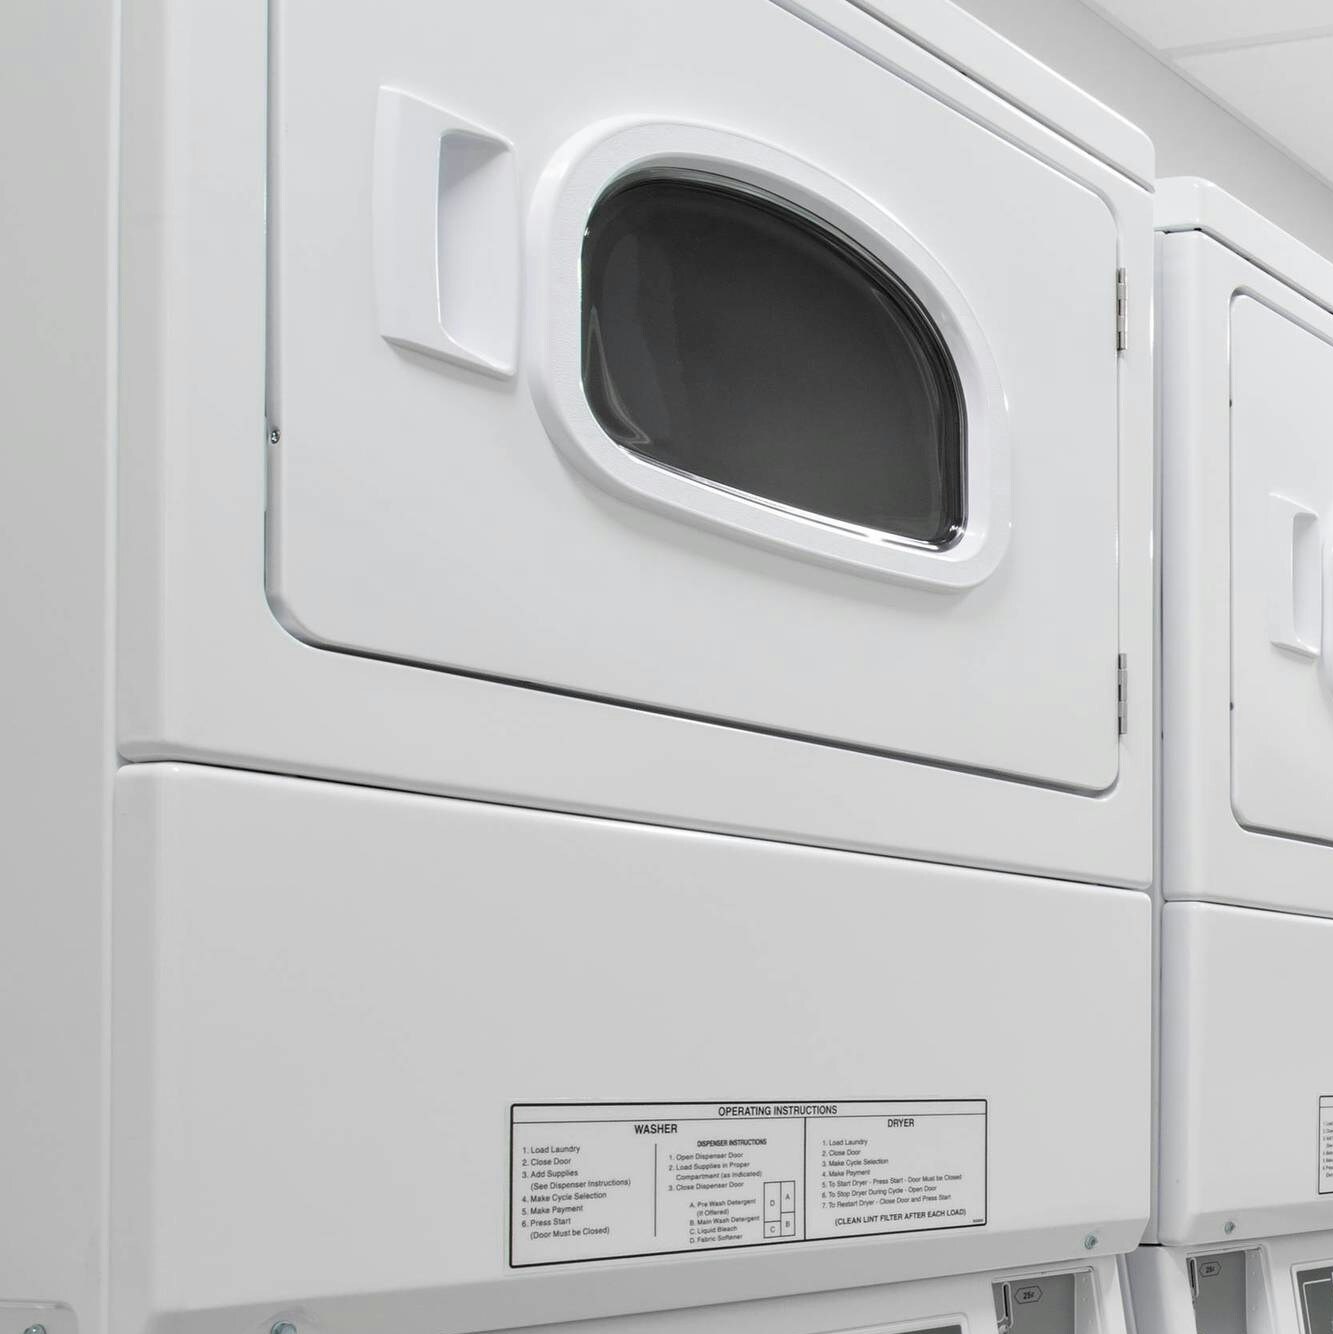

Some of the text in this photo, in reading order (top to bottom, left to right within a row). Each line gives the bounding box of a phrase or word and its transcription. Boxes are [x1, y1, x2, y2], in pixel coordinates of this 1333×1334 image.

[718, 1105, 838, 1117] OPERATING INSTRUCTIONS
[887, 1118, 915, 1127] DRYER
[634, 1124, 678, 1134] WASHER
[729, 1138, 767, 1146] INSTRUCTIONS
[845, 1139, 868, 1147] Laundry
[530, 1146, 549, 1154] Load
[551, 1145, 580, 1154] Laundry
[676, 1154, 694, 1162] Open
[696, 1152, 727, 1160] Dispenser
[530, 1158, 552, 1166] Close
[694, 1162, 721, 1171] Supplies
[730, 1162, 750, 1170] Proper
[530, 1170, 545, 1178] Add
[547, 1170, 578, 1178] Supplies
[676, 1173, 719, 1181] Compartment
[846, 1169, 870, 1177] Payment
[530, 1179, 631, 1191] (See Dispenser Instructions)
[696, 1182, 727, 1190] Dispenser
[869, 1188, 887, 1196] During
[552, 1194, 572, 1202] Cycle
[574, 1192, 607, 1200] Selection
[552, 1205, 583, 1214] Payment
[835, 1218, 862, 1226] (CLEAN
[880, 1214, 903, 1222] FILTER
[904, 1212, 926, 1220] AFTER
[927, 1210, 945, 1218] EACH
[947, 1208, 966, 1217] LOAD)
[522, 1220, 529, 1228] 6.
[530, 1219, 552, 1227] Press
[530, 1232, 551, 1240] (Door
[582, 1227, 610, 1235] Closed)
